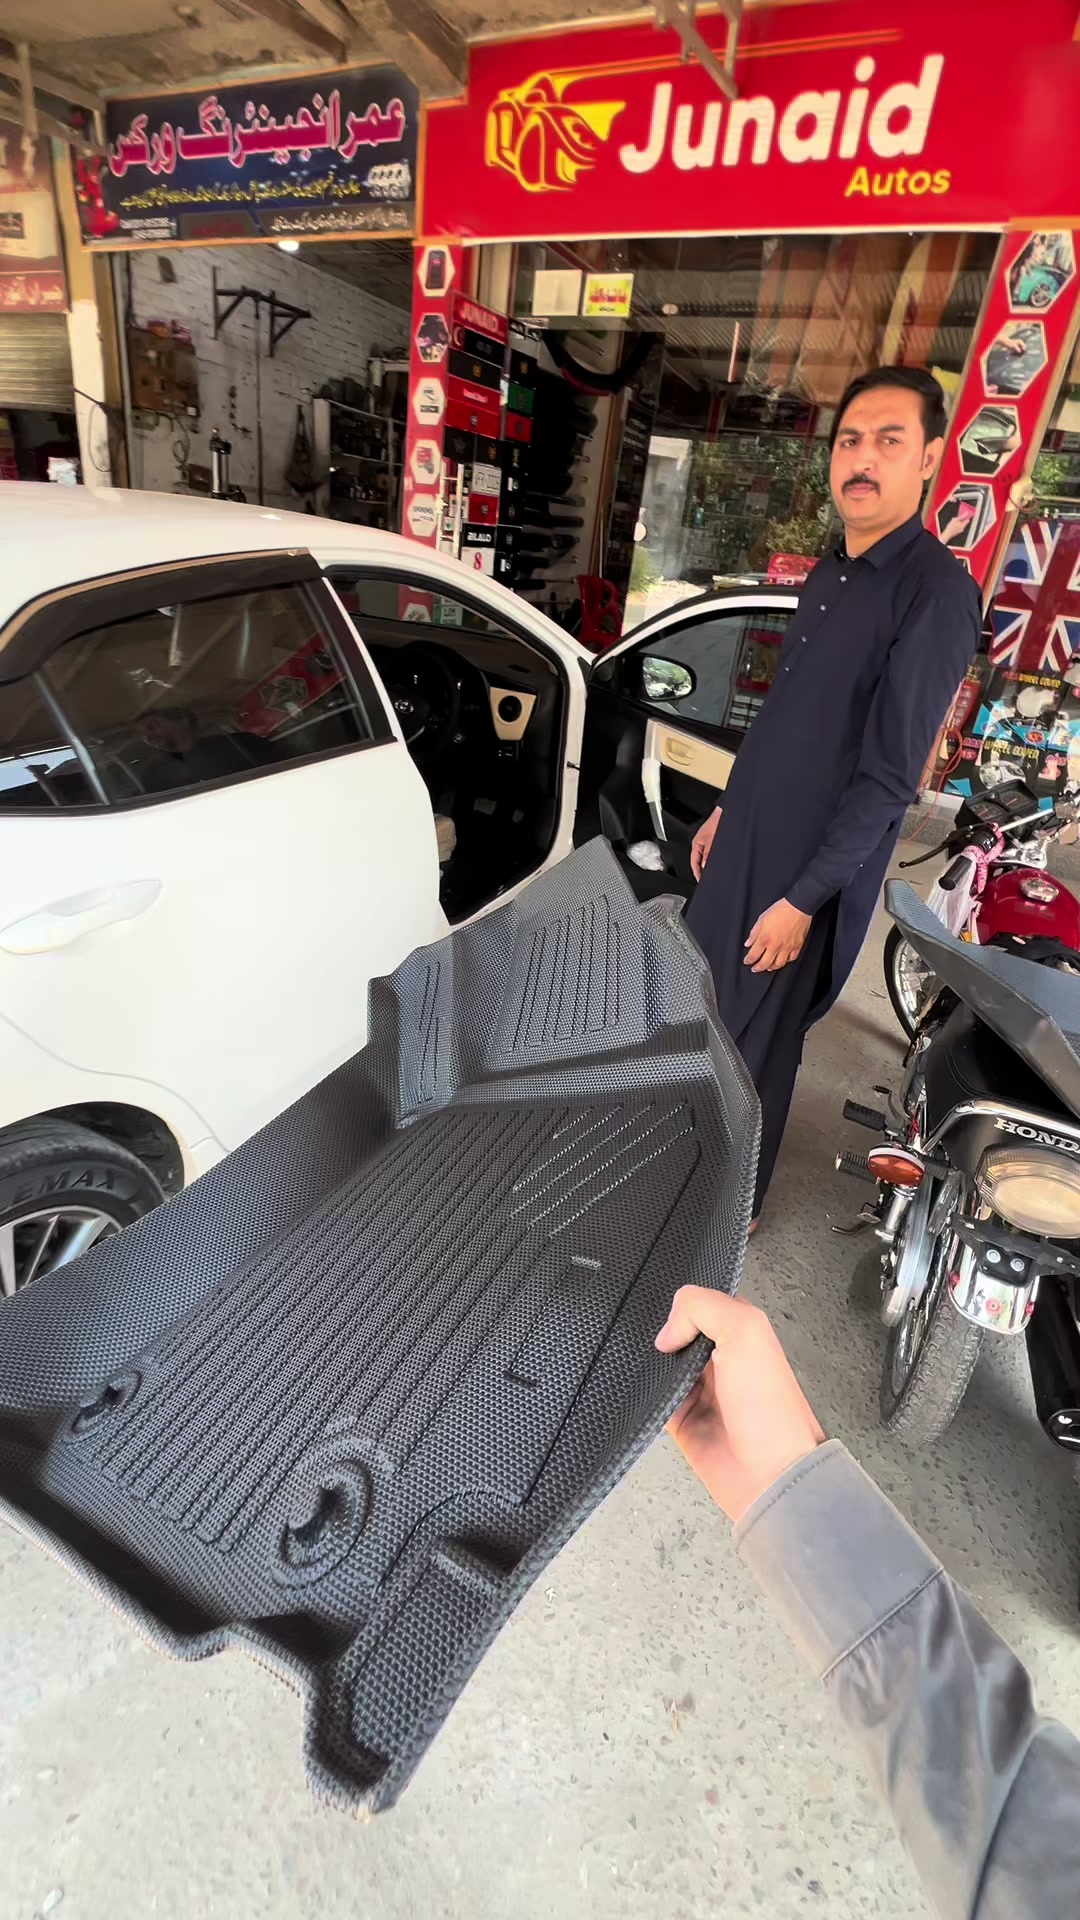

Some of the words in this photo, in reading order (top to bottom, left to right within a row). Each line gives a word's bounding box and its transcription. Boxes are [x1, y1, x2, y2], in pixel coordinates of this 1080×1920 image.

[338, 98, 405, 159] عمر
[620, 54, 945, 174] Junaid
[844, 166, 951, 197] Autos
[994, 1117, 1080, 1154] HOND
